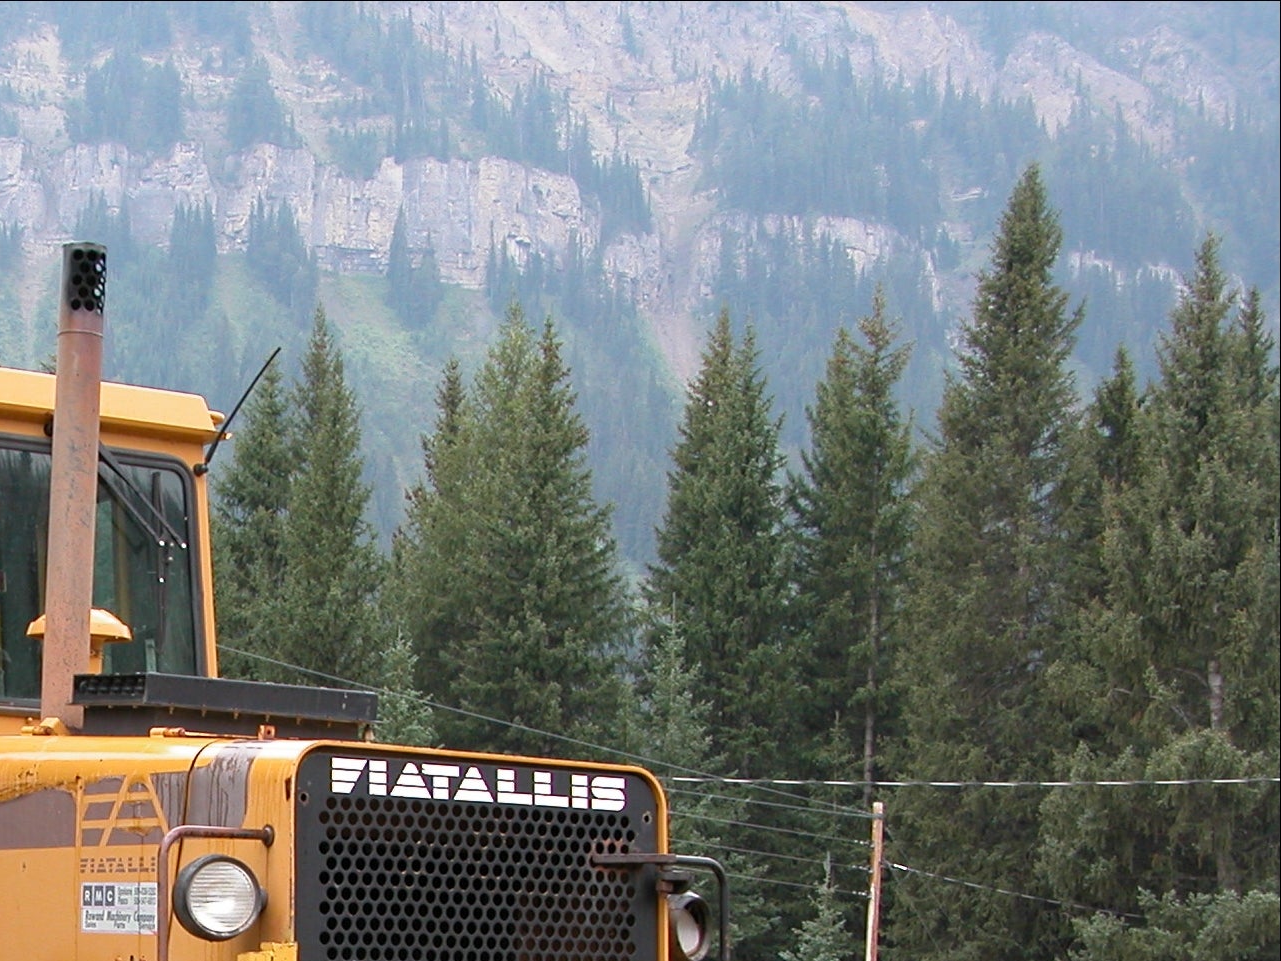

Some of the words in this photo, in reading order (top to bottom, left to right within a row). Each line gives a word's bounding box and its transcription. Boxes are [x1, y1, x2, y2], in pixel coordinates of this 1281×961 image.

[331, 757, 626, 812] FIATALLIS
[80, 857, 156, 874] FIATALLI
[133, 911, 156, 923] Company
